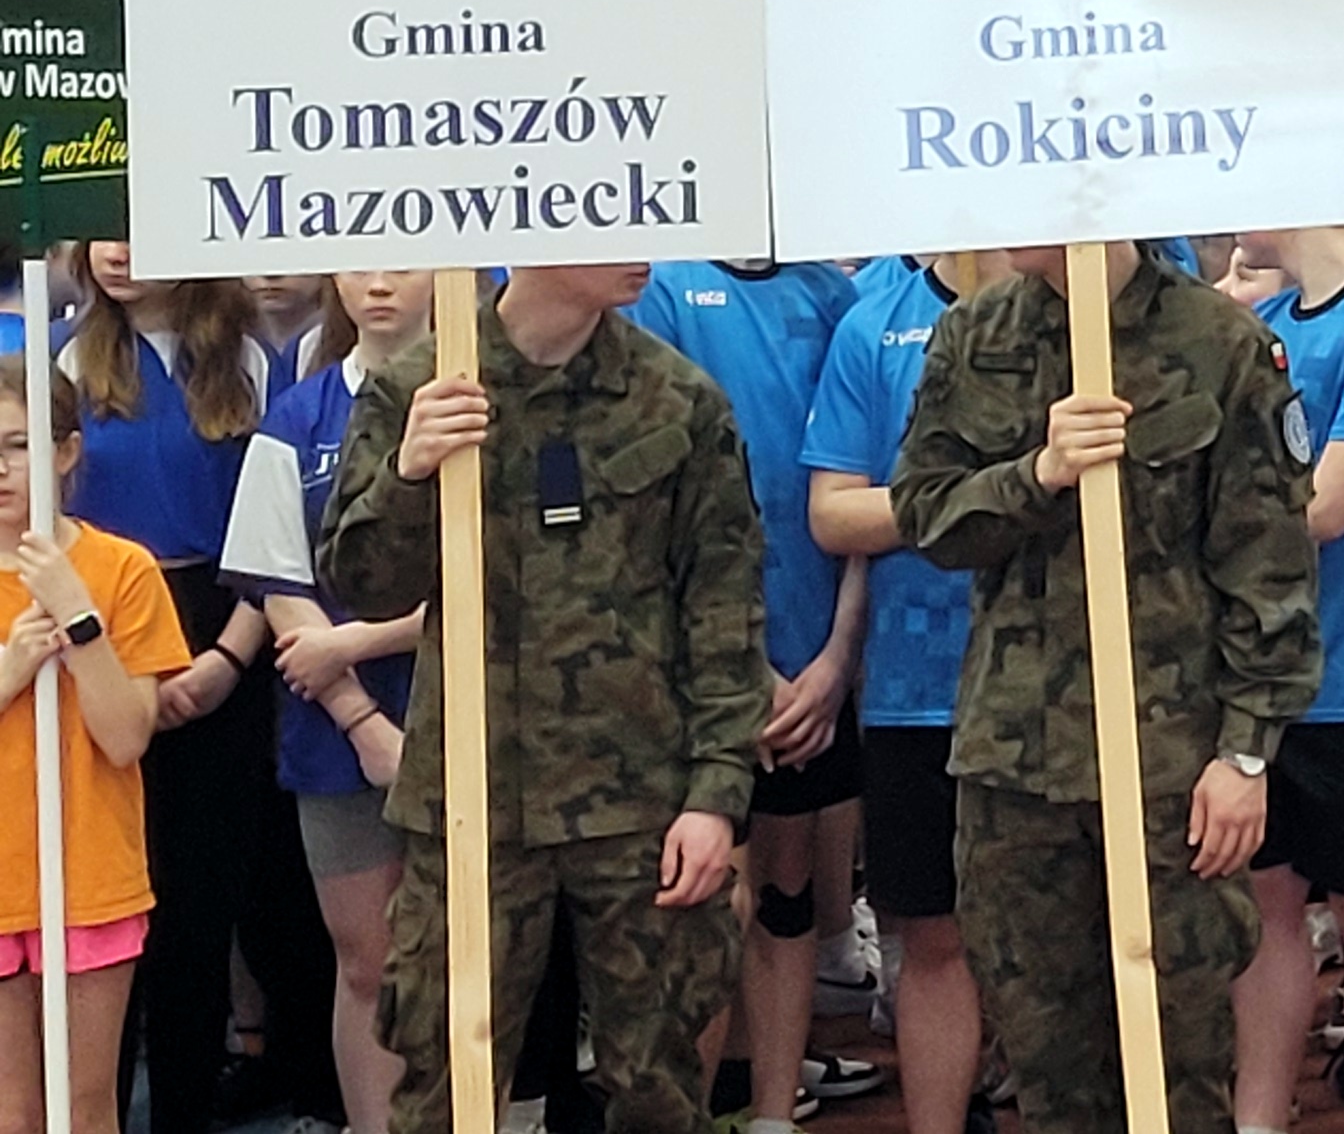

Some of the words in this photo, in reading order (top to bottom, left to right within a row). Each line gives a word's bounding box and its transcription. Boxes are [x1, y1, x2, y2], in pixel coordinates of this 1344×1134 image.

[0, 19, 86, 56] mina
[352, 10, 546, 58] Gmina
[979, 11, 1167, 61] Gmina
[232, 77, 667, 154] Tomaszów
[899, 94, 1258, 172] Rokiciny
[202, 160, 702, 242] Mazowiecki
